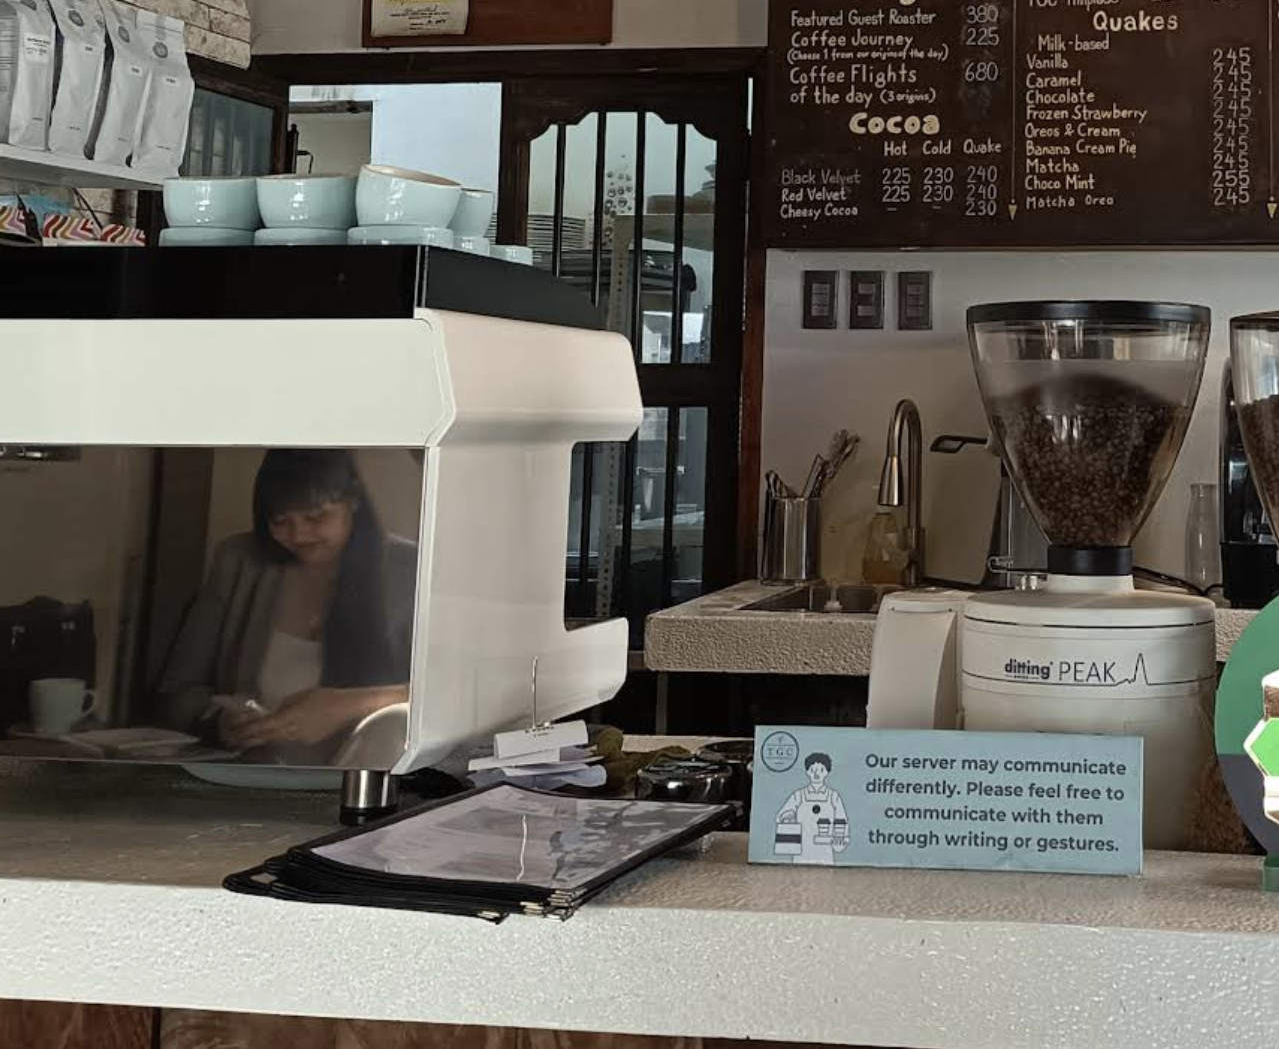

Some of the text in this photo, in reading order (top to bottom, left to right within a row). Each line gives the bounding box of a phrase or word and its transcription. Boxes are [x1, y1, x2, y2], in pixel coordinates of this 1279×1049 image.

[791, 8, 936, 26] Featured Guest Roaster
[1093, 10, 1178, 31] Quakes
[791, 28, 913, 50] Coffee Journey
[1027, 53, 1068, 70] Vanilla
[790, 64, 917, 87] Coffee Flights
[1026, 70, 1081, 88] Caramel
[790, 87, 807, 102] of
[814, 88, 839, 104] the
[847, 87, 872, 108] day
[1026, 88, 1095, 104] Chocolate
[1026, 103, 1148, 124] Frozen Strawberry
[849, 112, 940, 134] Cocoa
[1025, 122, 1120, 138] Oreos & Cream
[884, 139, 1001, 156] Hot Cold Quake
[1026, 139, 1136, 156] Banana Cream Pie
[1026, 158, 1079, 173] Matcha
[781, 169, 861, 187] Black Velvet
[1025, 173, 1094, 190] Choco Mint
[782, 187, 847, 201] Red Velvet
[1026, 194, 1114, 209] Matcha Oreo
[781, 201, 858, 220] Cheesy Cocoa
[1005, 658, 1116, 683] ditting PEAK
[865, 753, 1127, 776] Our server may communicate
[865, 779, 1125, 800] differently. Please feel free to
[884, 804, 1104, 825] communicate with them
[868, 830, 1119, 853] through writing or gestures.
